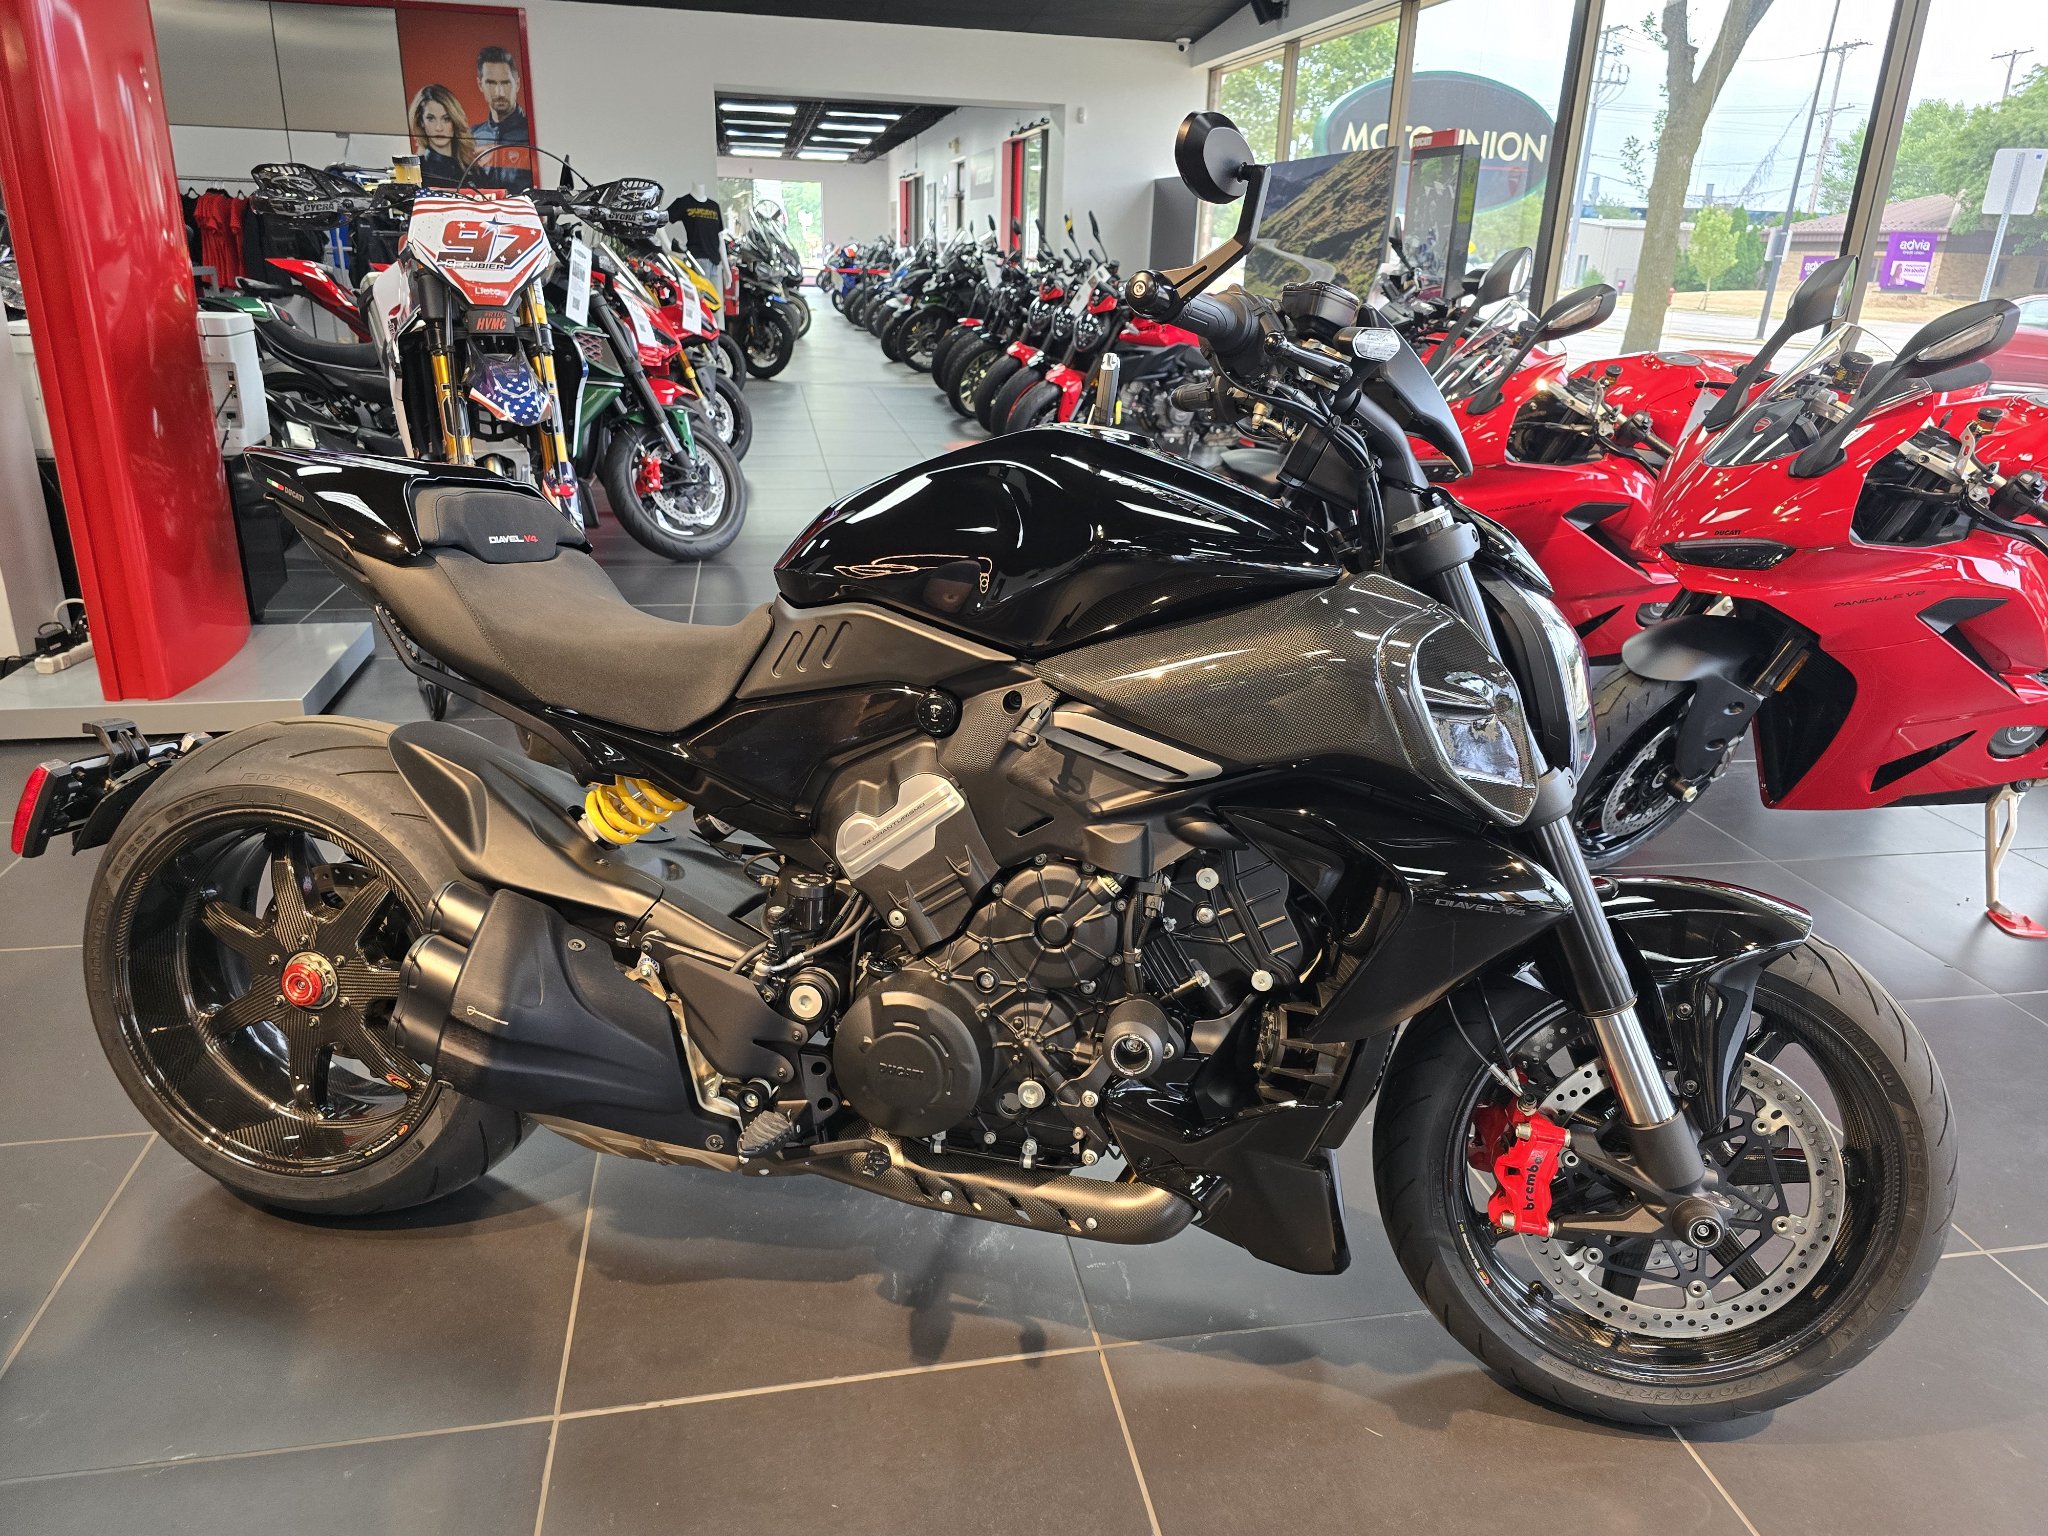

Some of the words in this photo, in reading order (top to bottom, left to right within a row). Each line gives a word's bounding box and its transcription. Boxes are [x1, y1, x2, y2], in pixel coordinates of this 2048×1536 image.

[303, 202, 334, 212] CYCRA
[608, 212, 636, 222] CYCRA
[438, 220, 543, 262] 97
[1899, 239, 1931, 251] advia
[476, 317, 507, 331] HVMC
[284, 486, 305, 503] DUCATI
[488, 535, 524, 544] DIAVEL
[523, 534, 539, 543] V4
[1833, 592, 1904, 608] PANIGALE
[1905, 590, 1926, 598] V2
[862, 839, 872, 847] V4
[872, 802, 926, 841] GRANTURISMO
[1434, 898, 1501, 914] DIAVEL
[1502, 904, 1527, 917] V4
[879, 1062, 925, 1079] DUCATI
[1523, 1157, 1543, 1211] brembo
